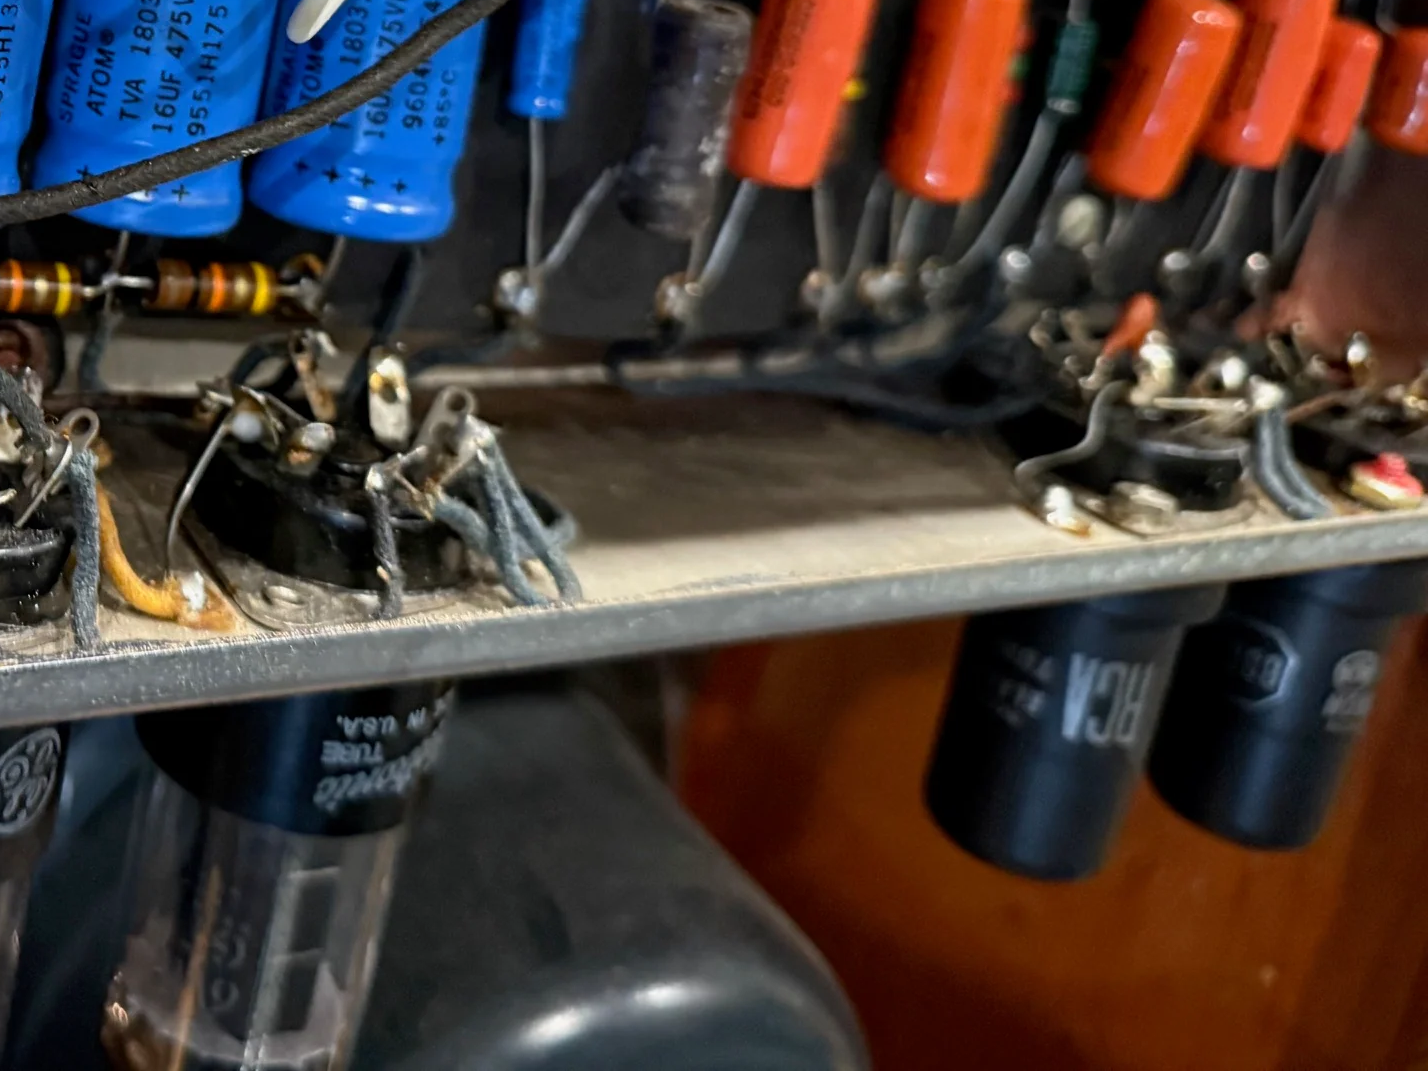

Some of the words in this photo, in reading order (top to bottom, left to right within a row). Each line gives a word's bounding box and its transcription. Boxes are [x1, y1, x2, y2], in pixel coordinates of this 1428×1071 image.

[61, 12, 92, 123] SPRAGUE
[119, 79, 146, 121] TVA
[153, 70, 181, 133] 16UF
[187, 6, 228, 136] 9551H175
[1063, 653, 1155, 747] RCA
